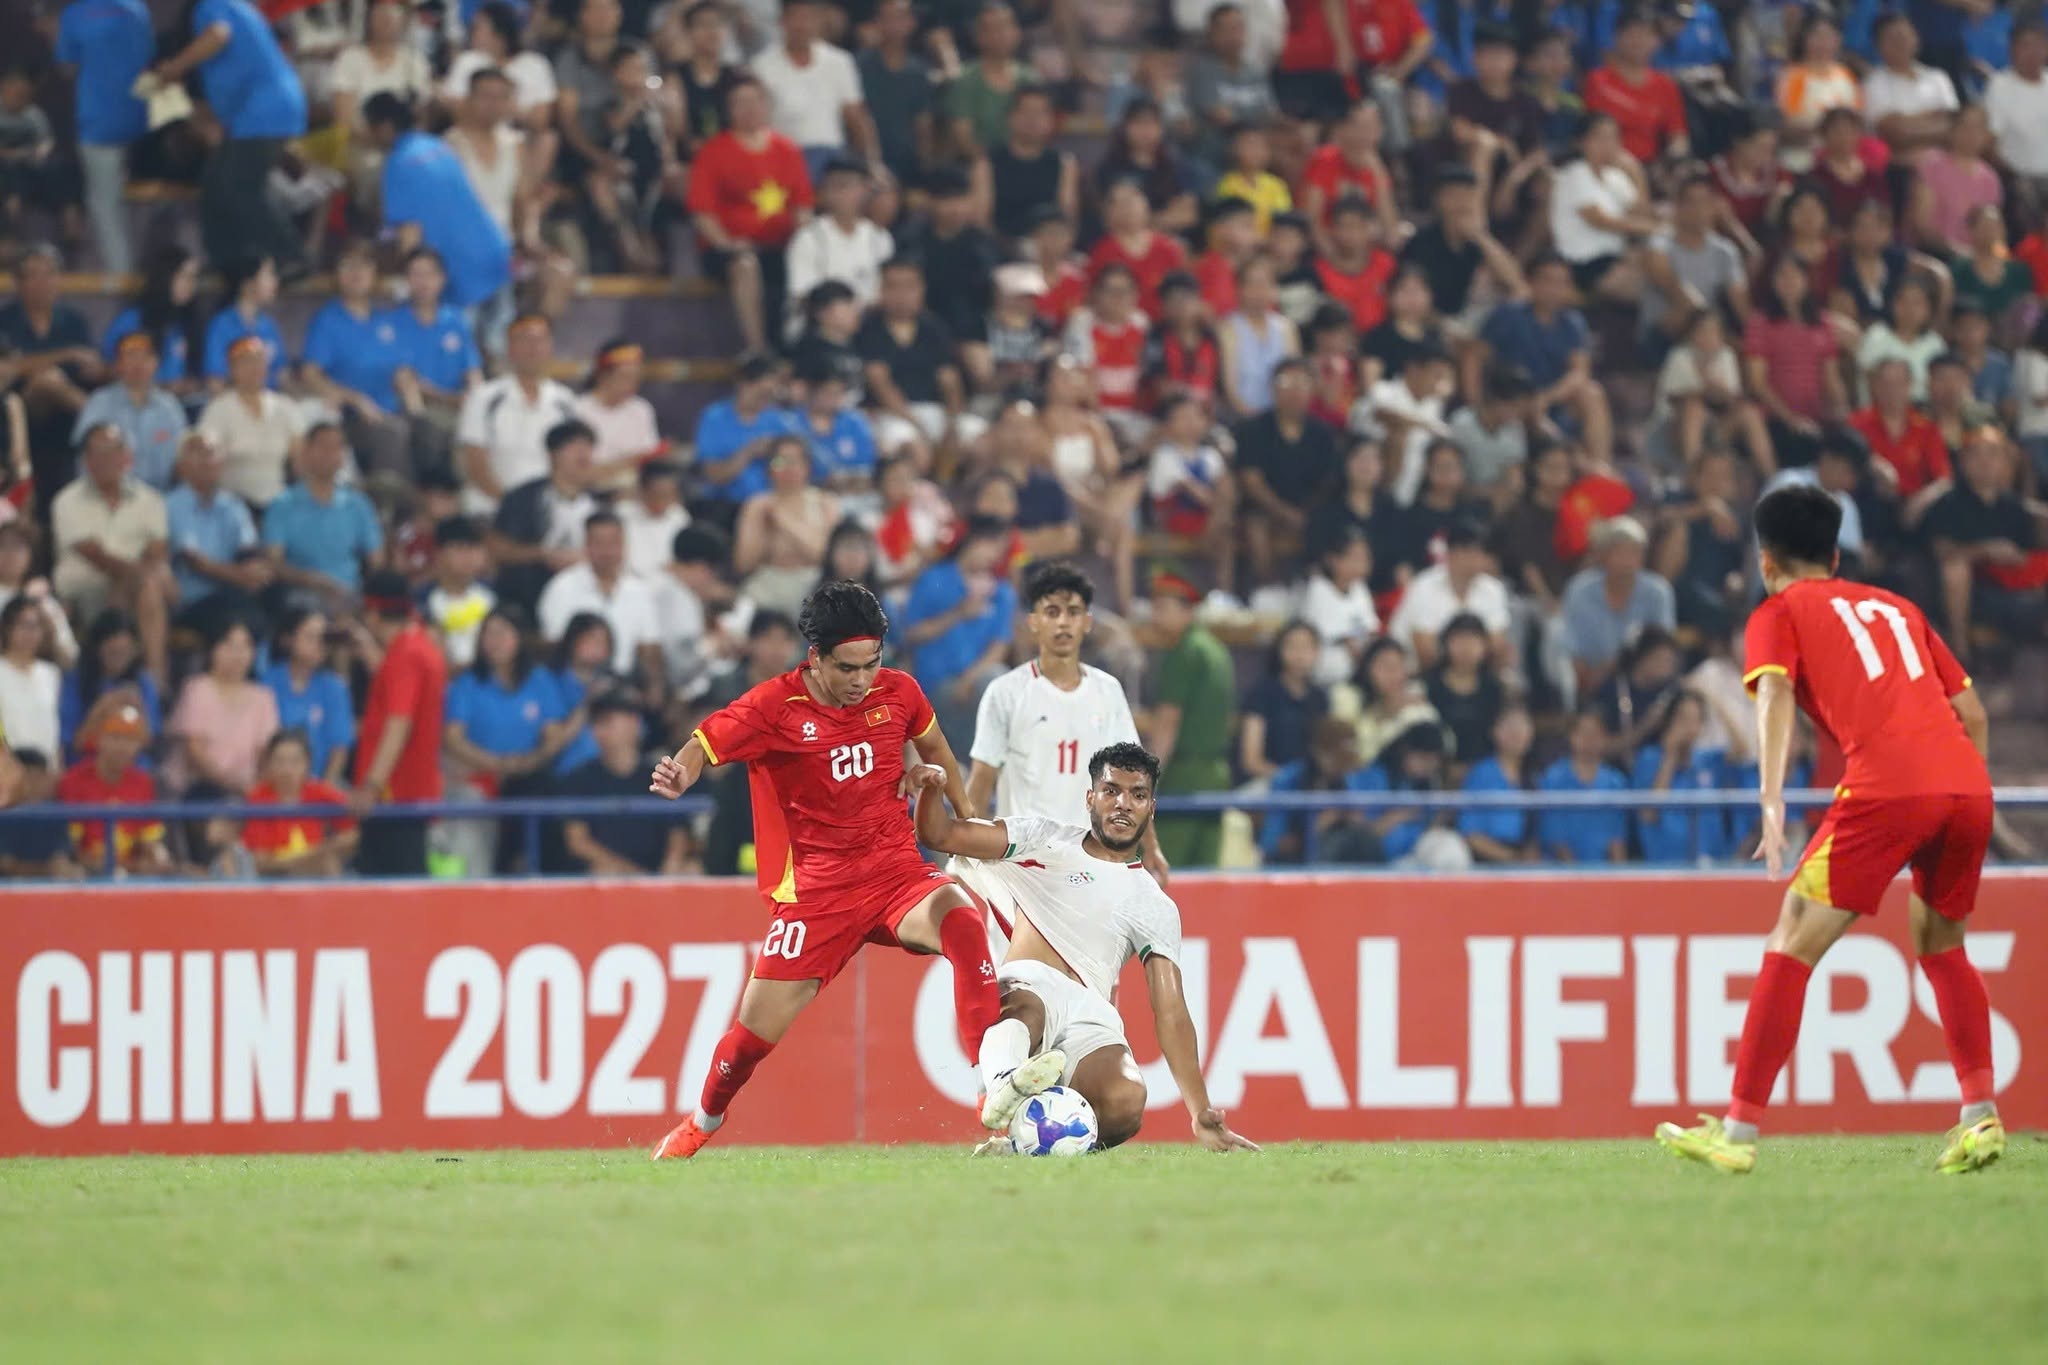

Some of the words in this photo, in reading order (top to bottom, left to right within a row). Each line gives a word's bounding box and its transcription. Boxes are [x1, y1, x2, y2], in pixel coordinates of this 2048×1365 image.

[1830, 596, 1925, 682] 17
[830, 741, 874, 782] 20
[1058, 739, 1078, 775] 11
[763, 918, 807, 960] 20
[16, 948, 381, 1127] CHINA
[424, 943, 746, 1120] 2027
